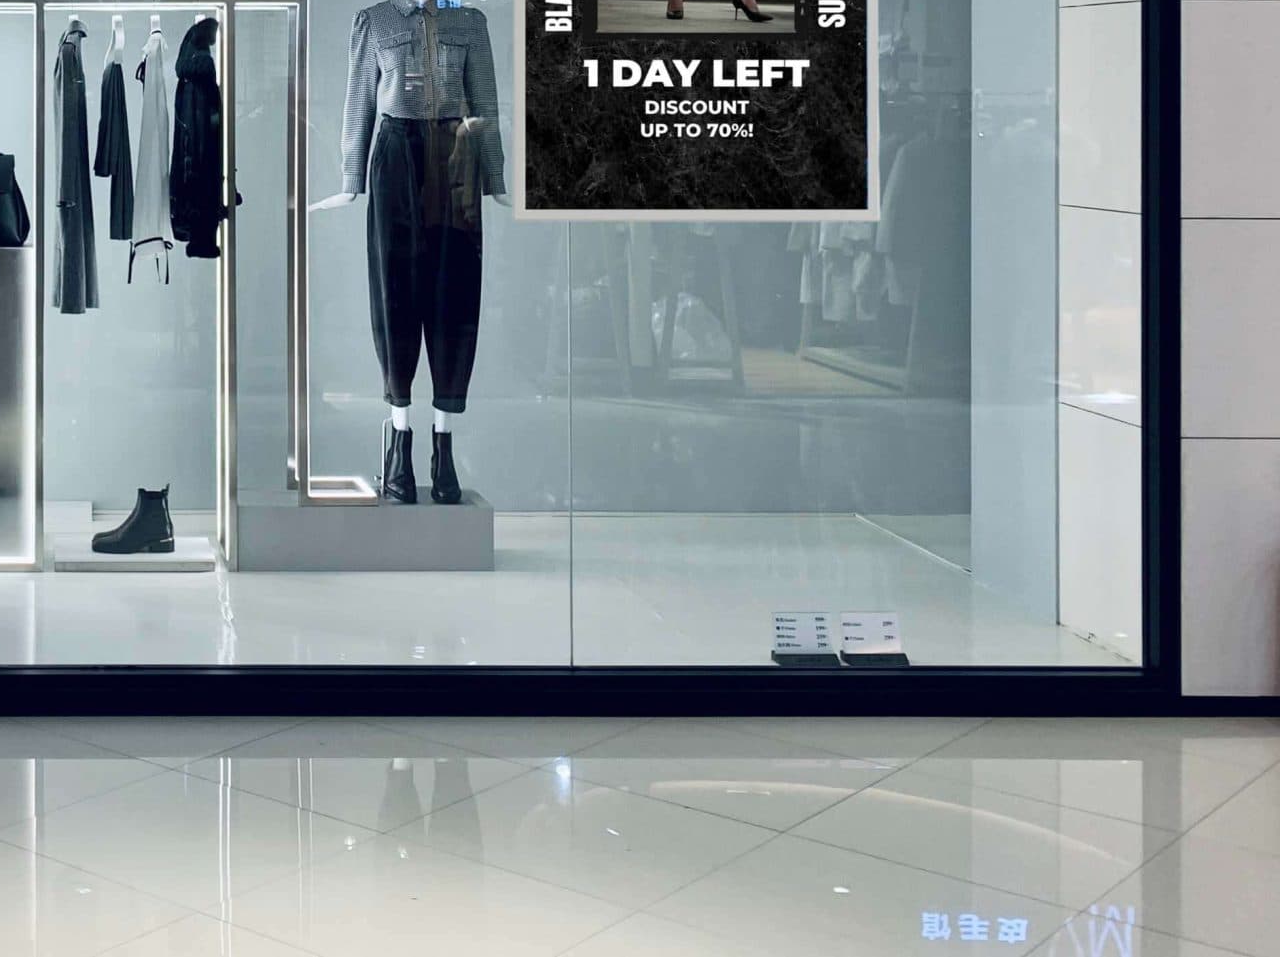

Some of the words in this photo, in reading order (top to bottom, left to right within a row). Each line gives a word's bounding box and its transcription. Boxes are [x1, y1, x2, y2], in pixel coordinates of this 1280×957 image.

[583, 59, 599, 87] 1
[612, 59, 701, 87] DAY
[712, 59, 810, 87] LEFT
[644, 100, 750, 115] DISCOUNT
[640, 123, 668, 138] UP
[672, 123, 702, 138] TO
[706, 123, 754, 138] 70%!
